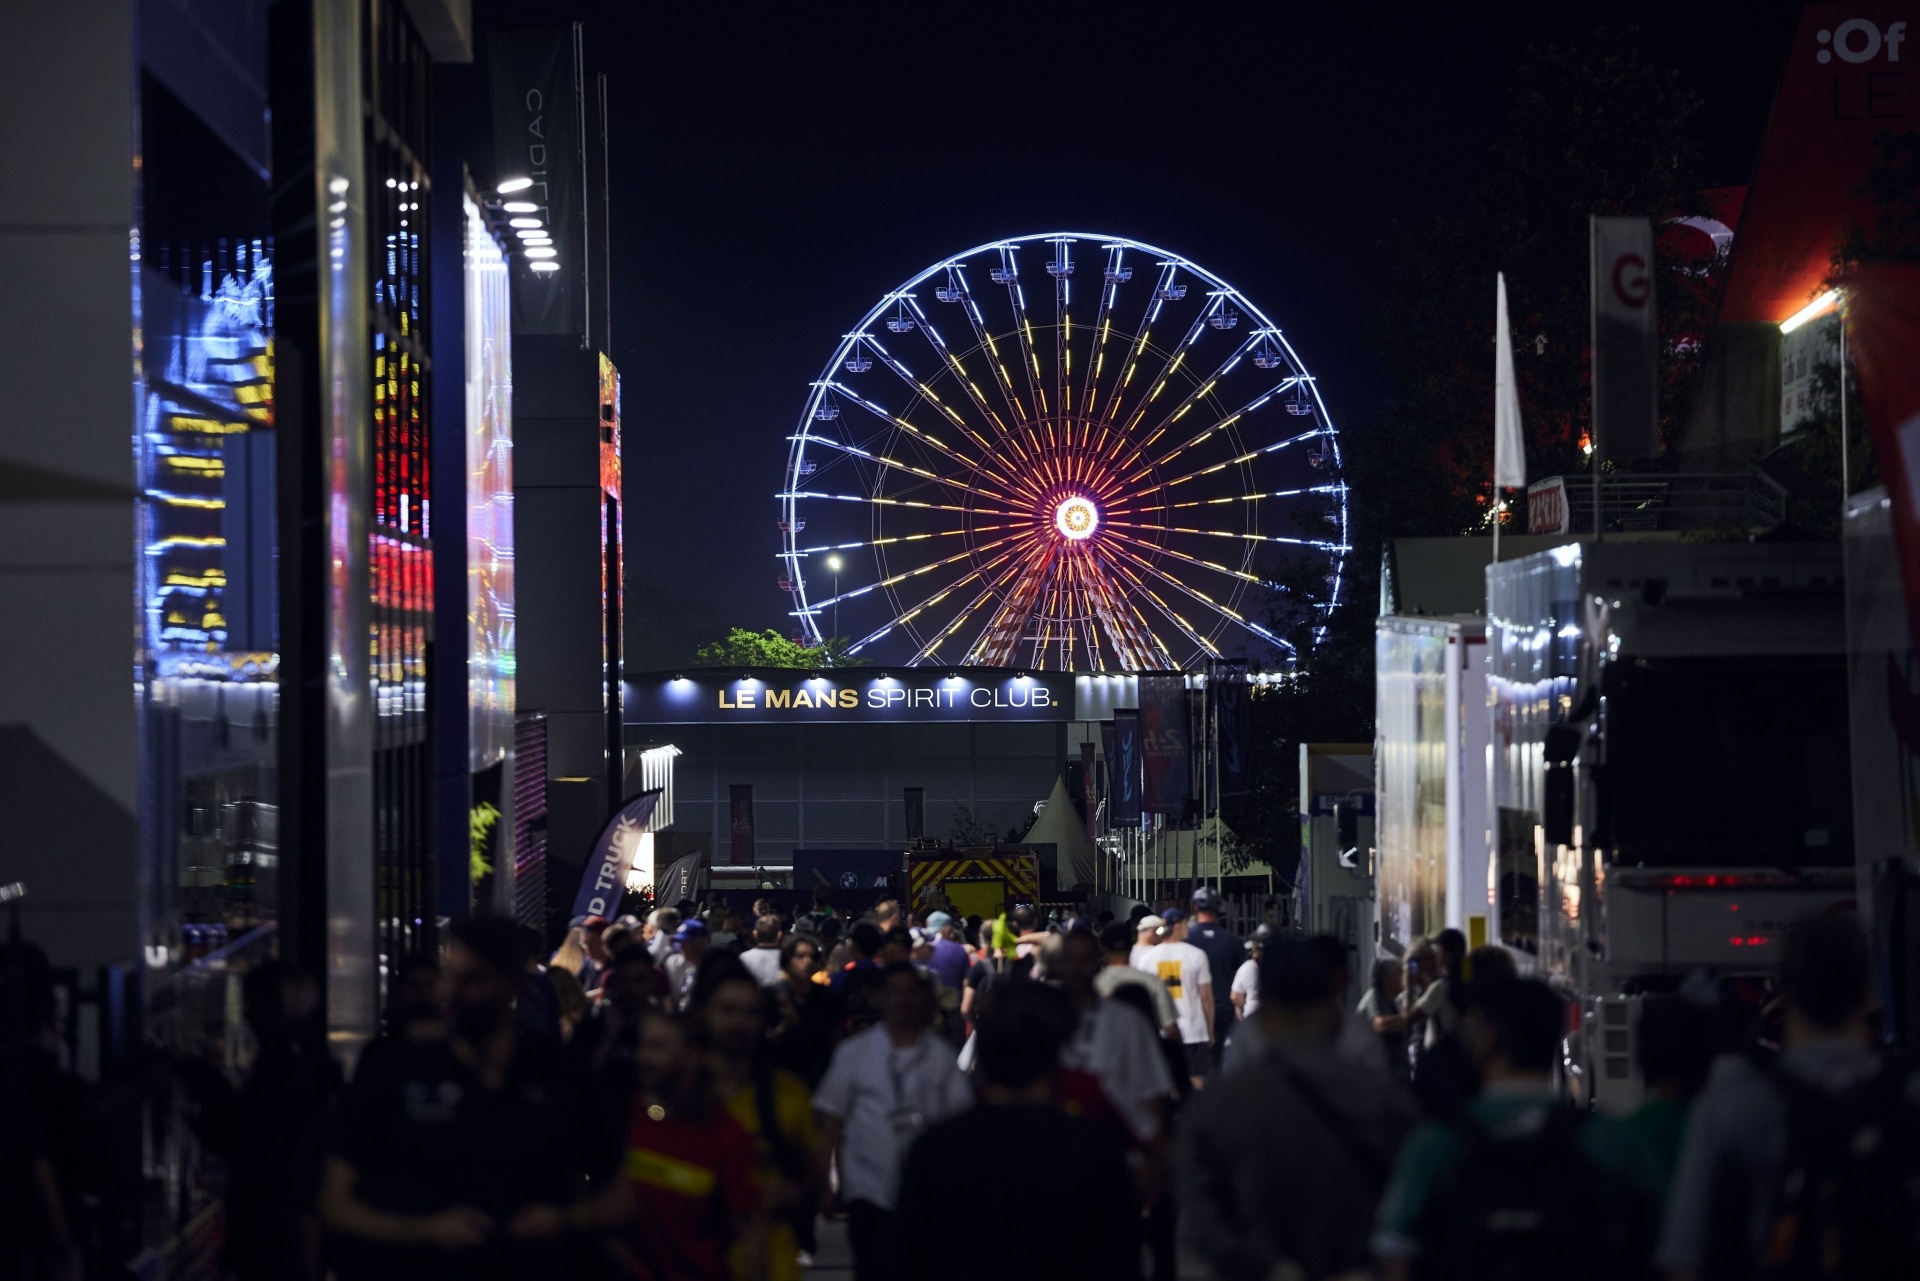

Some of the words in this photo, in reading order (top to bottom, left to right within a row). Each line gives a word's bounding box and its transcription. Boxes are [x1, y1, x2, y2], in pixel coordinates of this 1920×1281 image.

[1834, 72, 1902, 119] LE
[719, 689, 756, 709] LE
[765, 689, 858, 709] MANS
[867, 688, 960, 708] SPIRIT
[971, 688, 1058, 708] CLUB.
[594, 814, 637, 891] TRUCK
